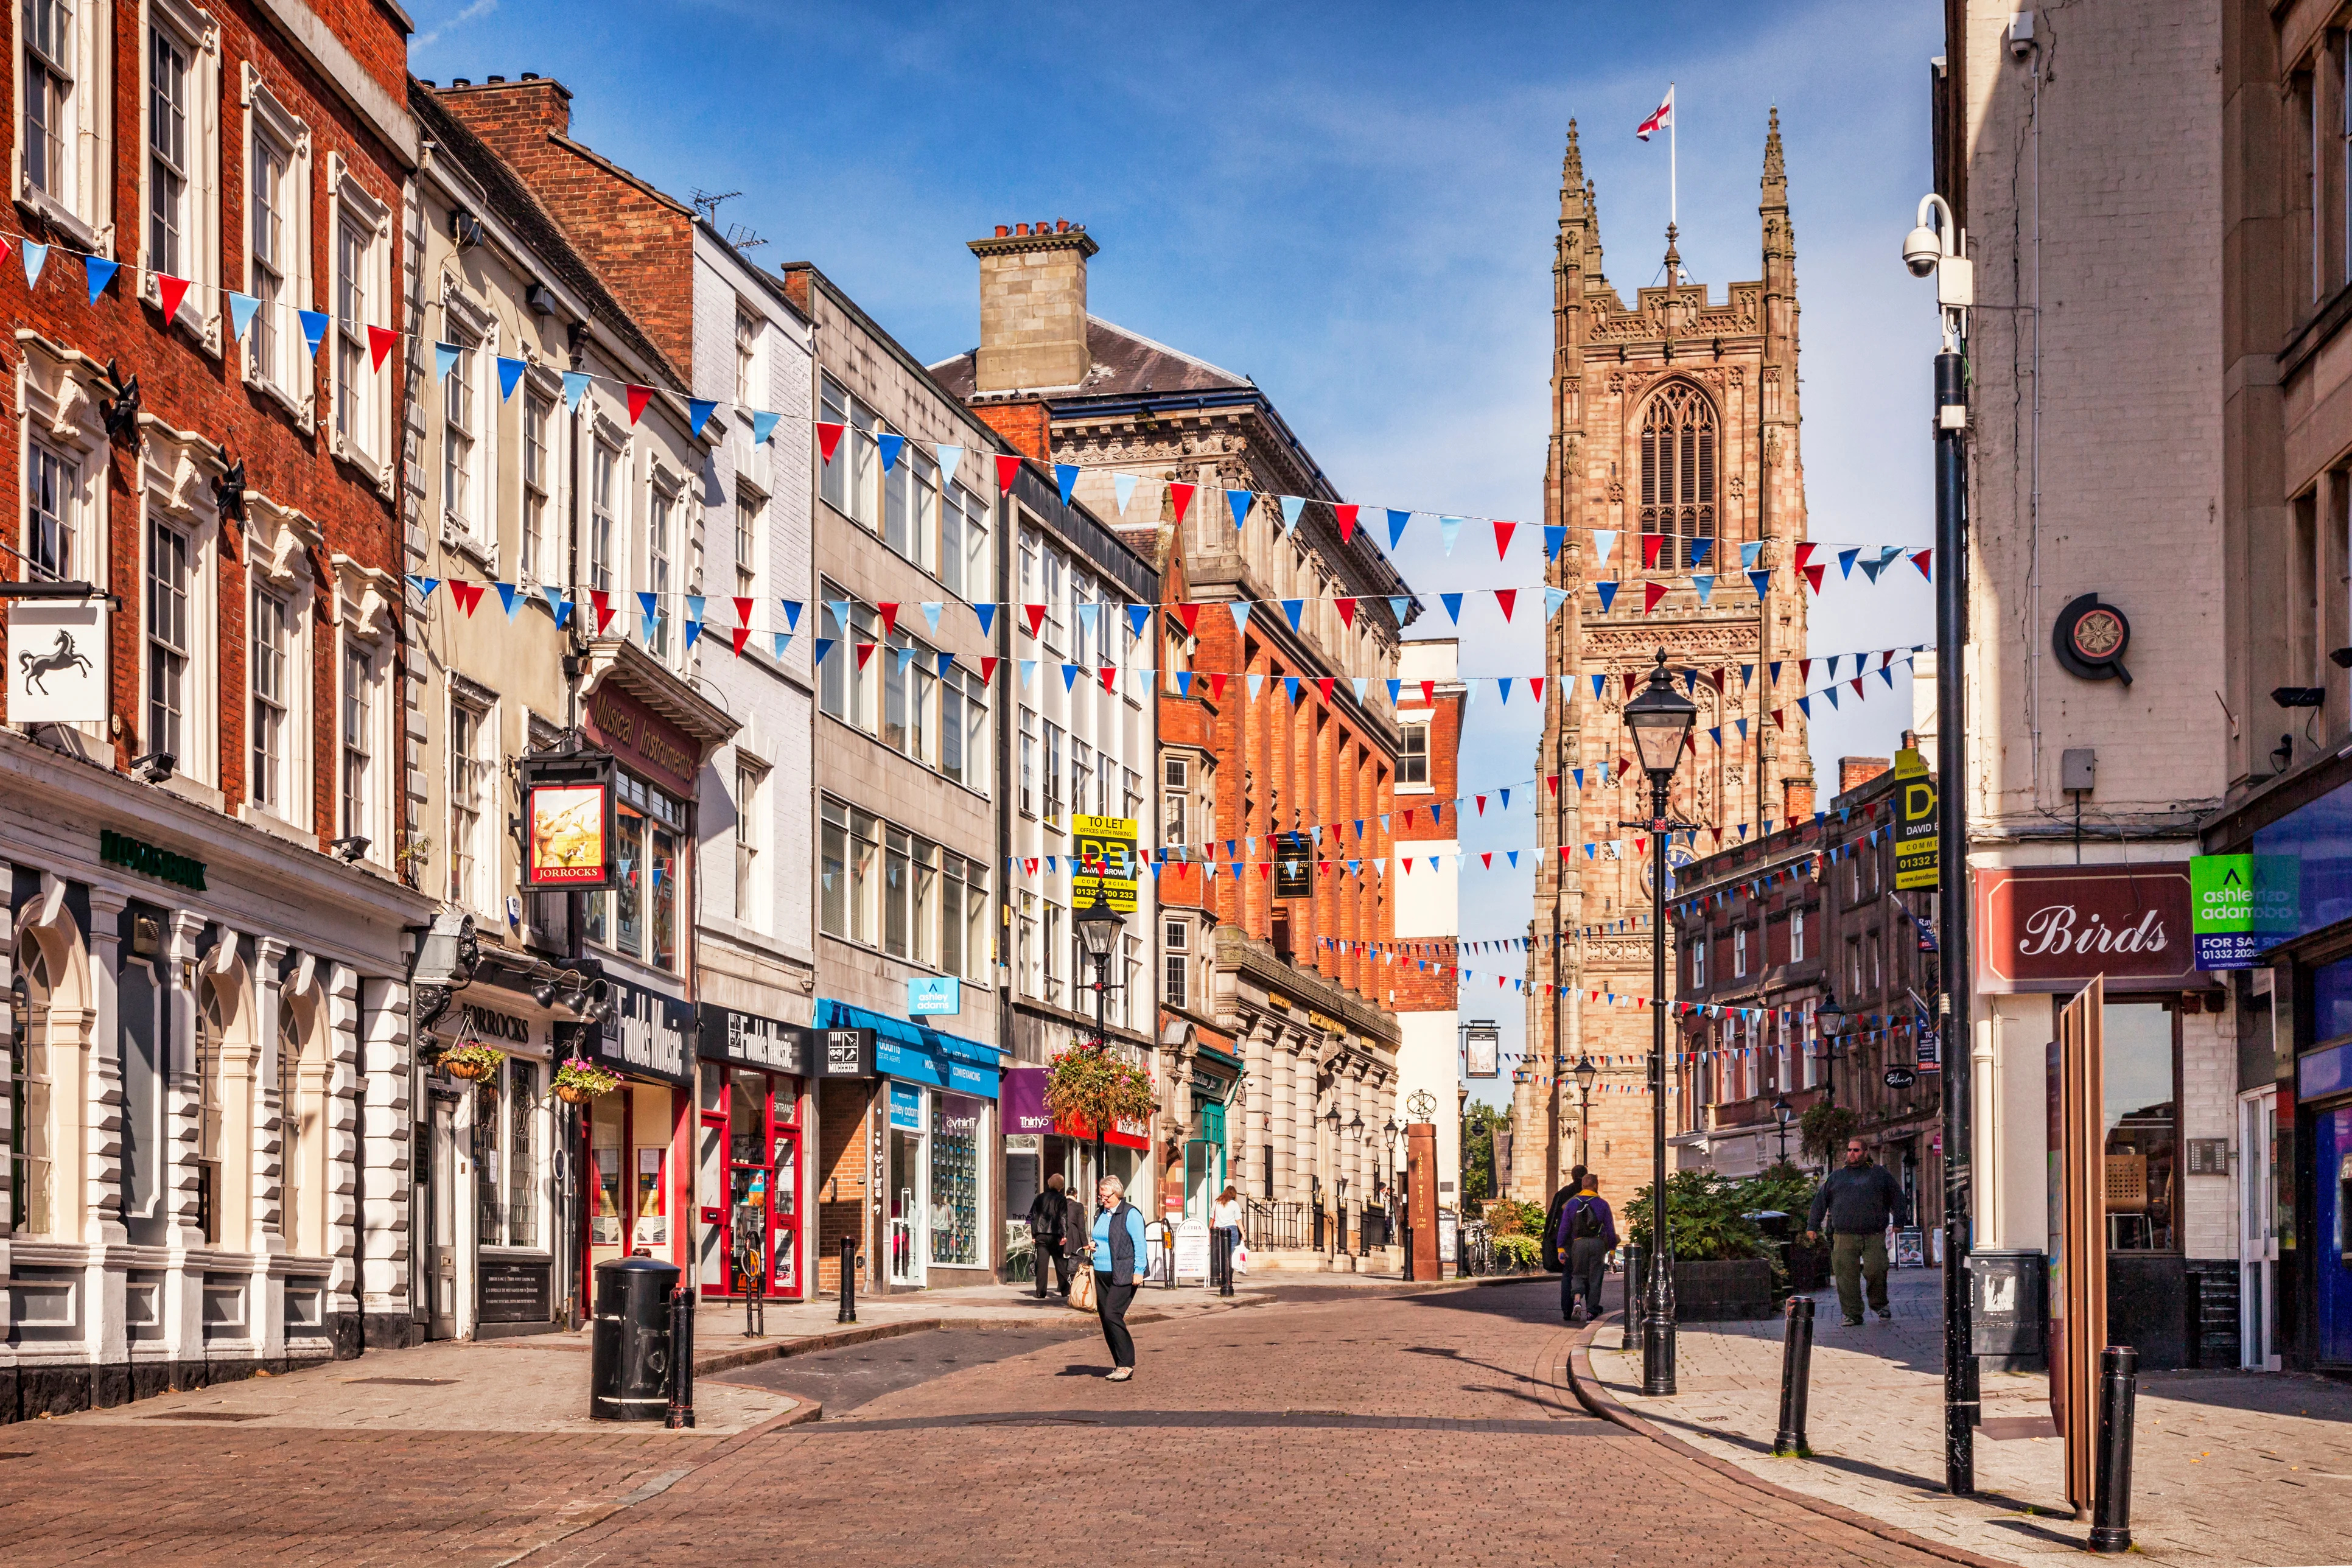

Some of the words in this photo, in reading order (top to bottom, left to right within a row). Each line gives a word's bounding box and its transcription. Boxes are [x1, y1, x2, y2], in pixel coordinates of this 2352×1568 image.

[593, 691, 636, 746] Musical
[639, 719, 694, 782] Instruments
[1088, 816, 1102, 827] TO
[1105, 819, 1124, 829] LET
[1906, 824, 1931, 835] DAVID
[1906, 839, 1938, 851] COMME
[1900, 856, 1930, 869] 01332
[161, 851, 208, 891] BANK
[538, 868, 598, 880] JORROCKS
[2203, 887, 2253, 903] ashle
[2201, 905, 2254, 920] adam
[2019, 905, 2168, 955] Birds
[2202, 937, 2232, 948] FOR
[2236, 937, 2255, 947] SA
[2203, 950, 2233, 959] 01332
[919, 993, 948, 1003] ashley
[461, 1003, 529, 1044] JORROCKS
[618, 985, 651, 1067] Foulds
[651, 998, 682, 1076] Music
[740, 1015, 767, 1063] Foulds
[768, 1021, 793, 1069] Music
[879, 1035, 901, 1055] adams
[878, 1052, 889, 1060] ESTATE
[889, 1053, 900, 1063] AGENTS
[936, 1046, 948, 1057] SALES
[828, 1063, 858, 1073] MDCCCXCIII
[925, 1059, 948, 1073] MORTGAGES
[953, 1066, 981, 1082] CONVEYANCING
[774, 1102, 796, 1115] ENTRANCE
